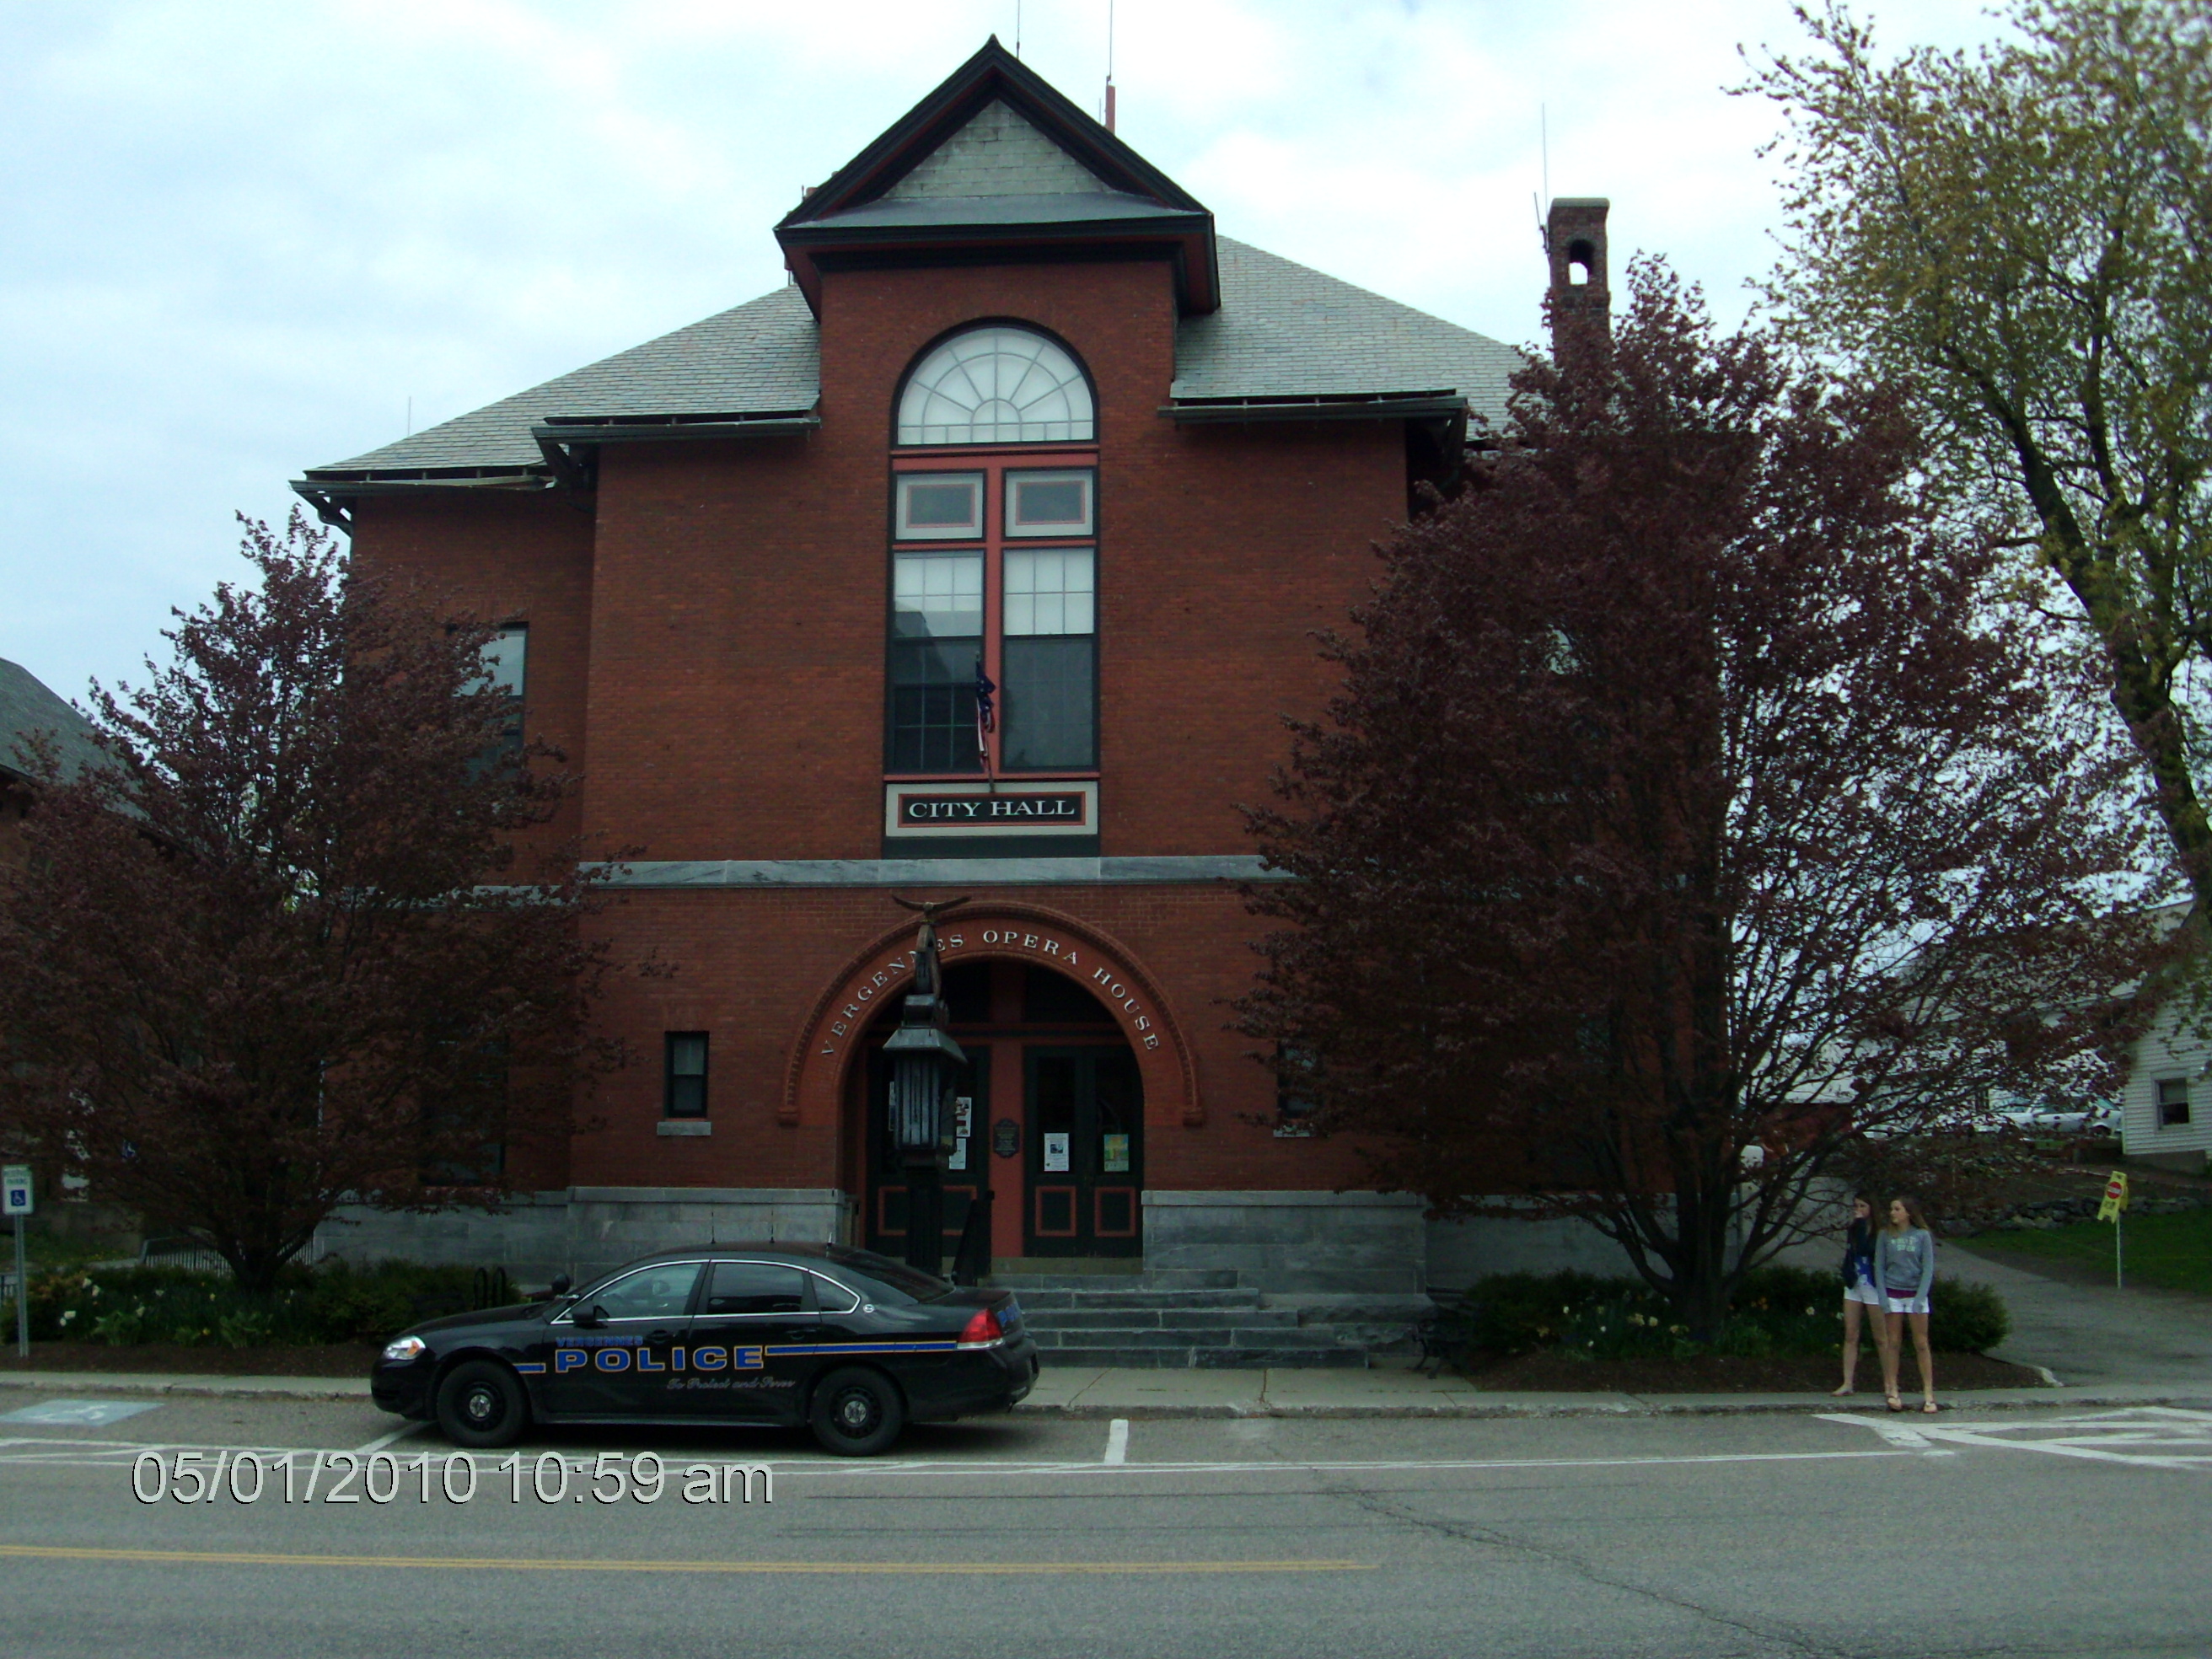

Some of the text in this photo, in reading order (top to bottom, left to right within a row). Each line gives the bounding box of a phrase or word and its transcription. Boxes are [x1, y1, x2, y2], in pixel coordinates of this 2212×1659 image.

[909, 800, 1075, 818] CITY HALL
[983, 930, 1079, 965] OPERA
[1092, 967, 1160, 1051] HOUSE
[556, 1346, 764, 1372] POLICE
